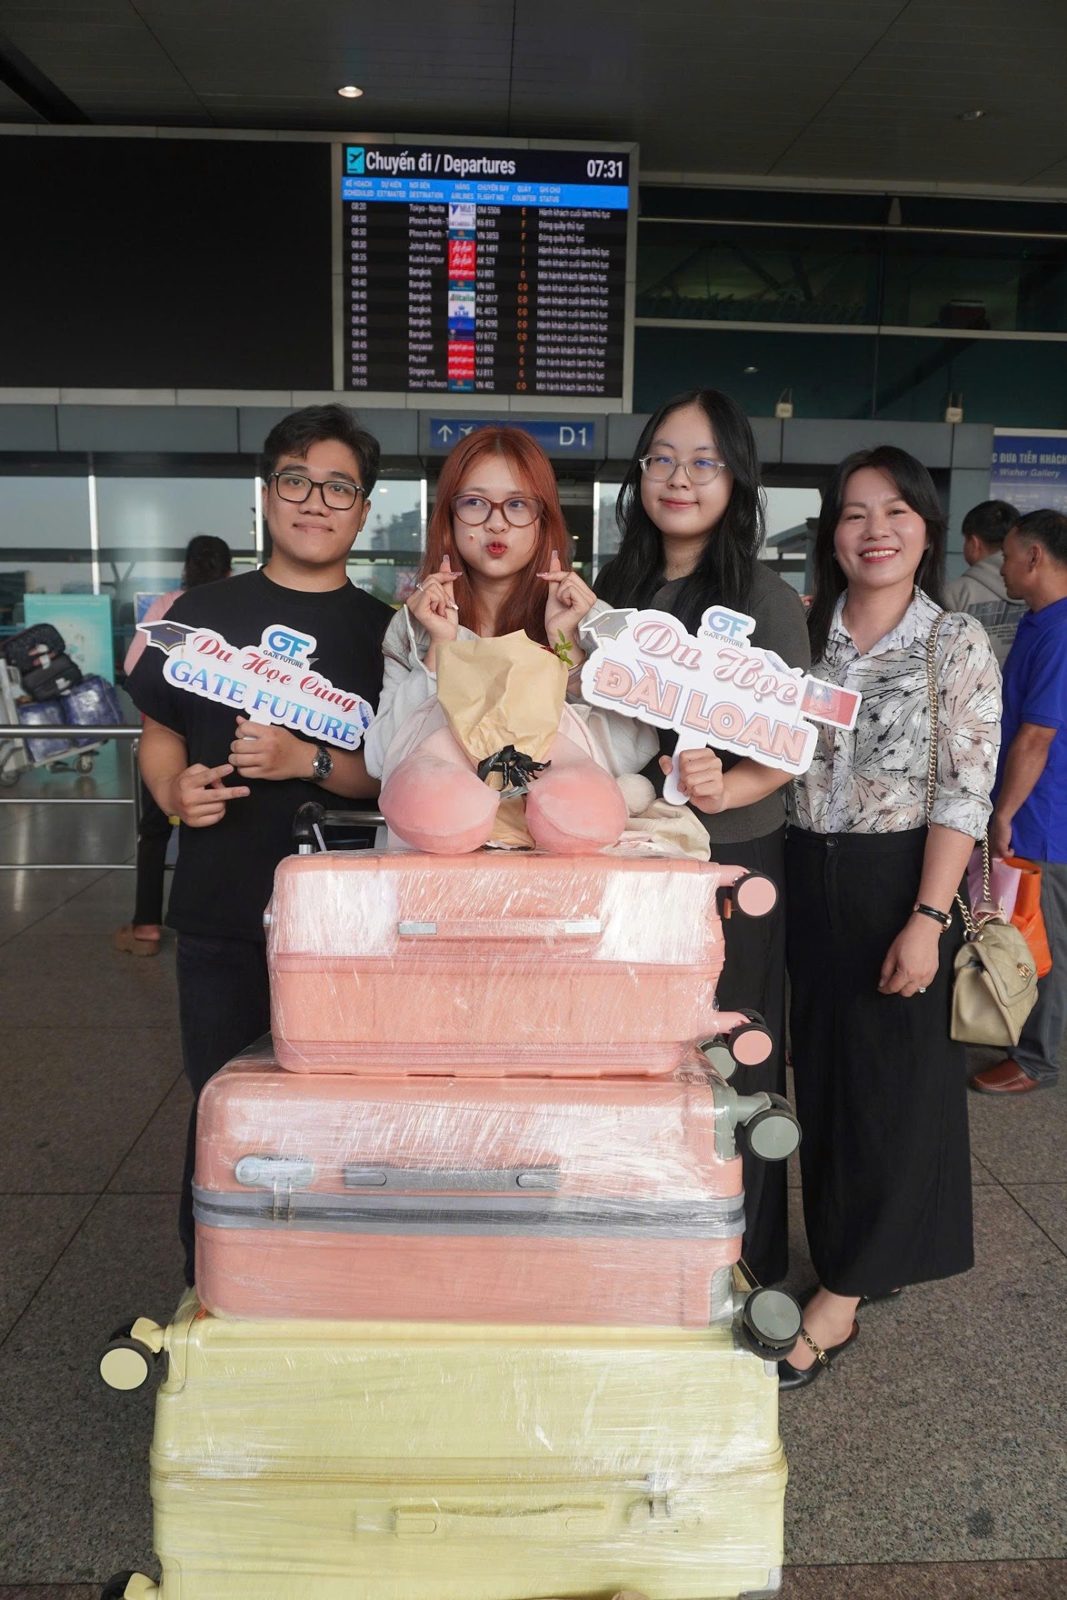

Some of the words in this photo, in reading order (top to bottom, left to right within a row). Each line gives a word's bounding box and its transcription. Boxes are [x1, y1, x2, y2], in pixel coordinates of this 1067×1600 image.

[365, 150, 415, 176] Chuyến
[418, 153, 433, 171] đi
[434, 154, 440, 173] /
[443, 154, 516, 178] Departures
[586, 159, 623, 179] 07:31
[559, 425, 587, 446] D1
[1030, 468, 1061, 480] Gallery
[707, 610, 750, 638] GF
[267, 630, 311, 658] GF
[193, 634, 233, 664] Du
[241, 652, 292, 686] Học
[299, 675, 360, 713] Cùng
[633, 620, 701, 670] Du
[713, 646, 800, 705] Học
[169, 660, 247, 704] GATE
[252, 689, 361, 745] FUTURE
[593, 657, 682, 721] ĐÀI
[682, 688, 810, 767] LOAN
